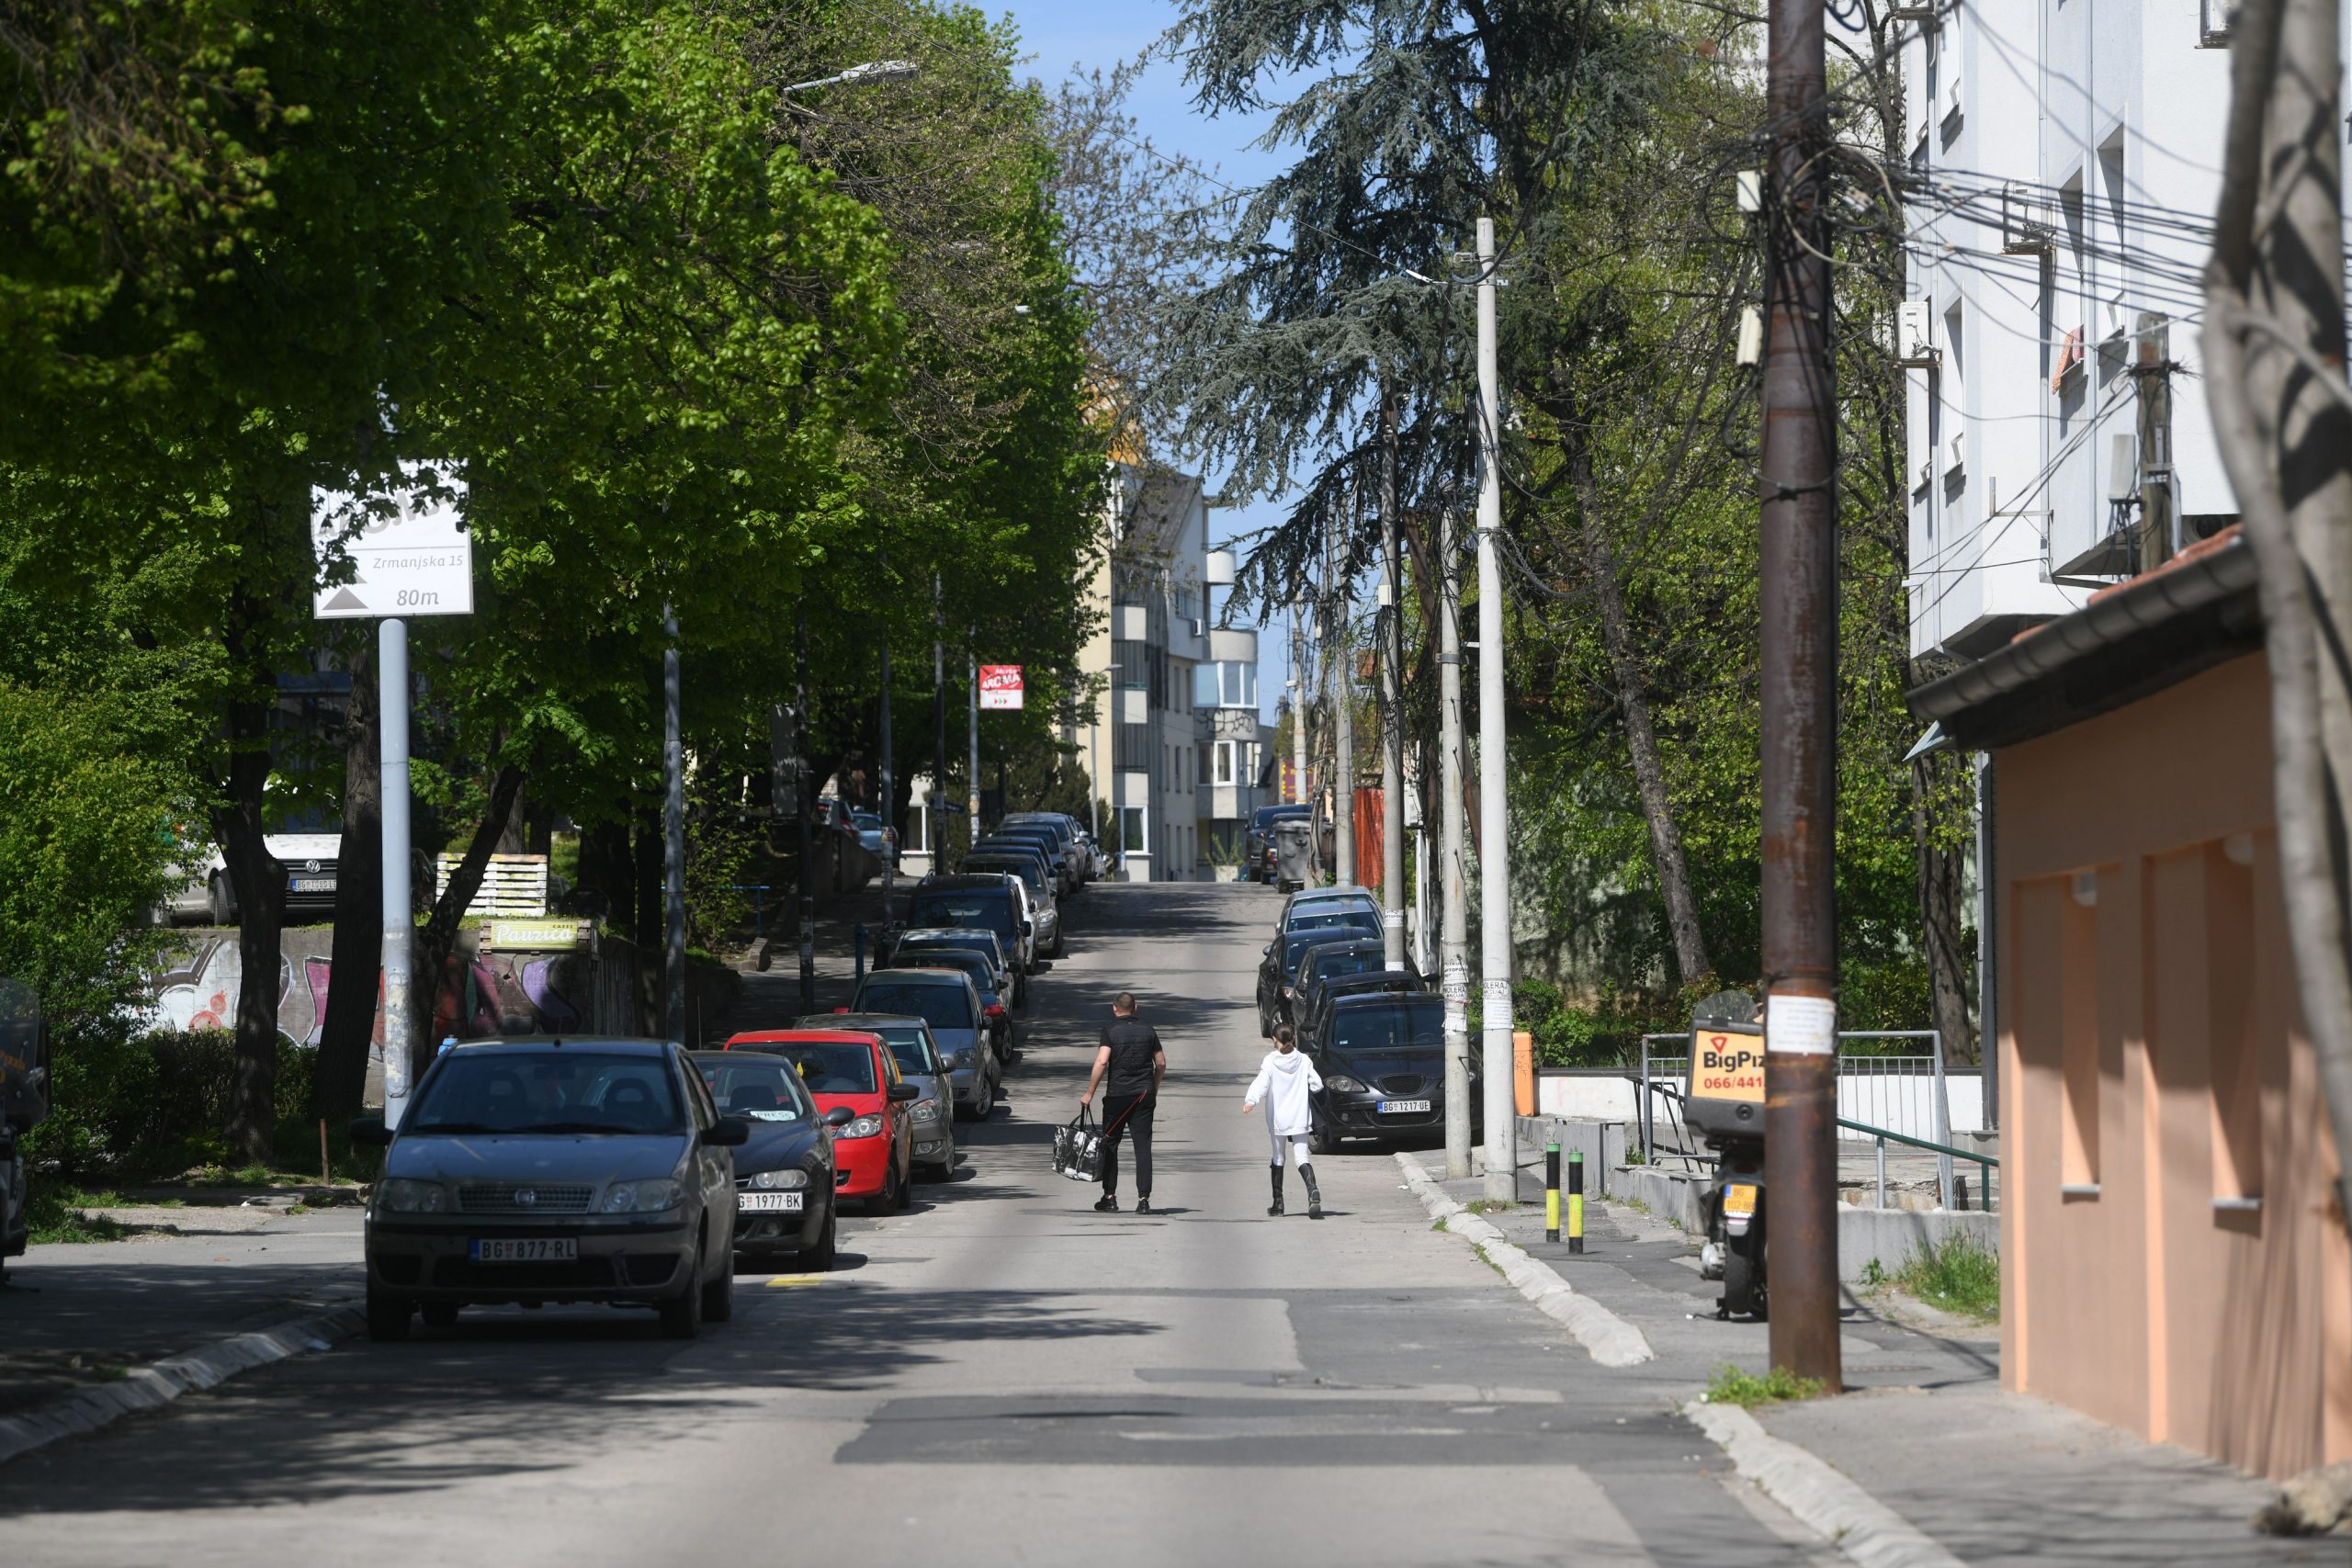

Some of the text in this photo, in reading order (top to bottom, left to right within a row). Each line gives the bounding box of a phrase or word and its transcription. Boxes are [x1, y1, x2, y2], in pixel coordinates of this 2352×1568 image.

[372, 555, 464, 570] Zrmanjska 15
[396, 589, 440, 607] 80m
[495, 924, 574, 945] Pauzica
[1703, 1076, 1765, 1089] 066/441
[1384, 1102, 1394, 1111] BG
[481, 1241, 503, 1258] BG
